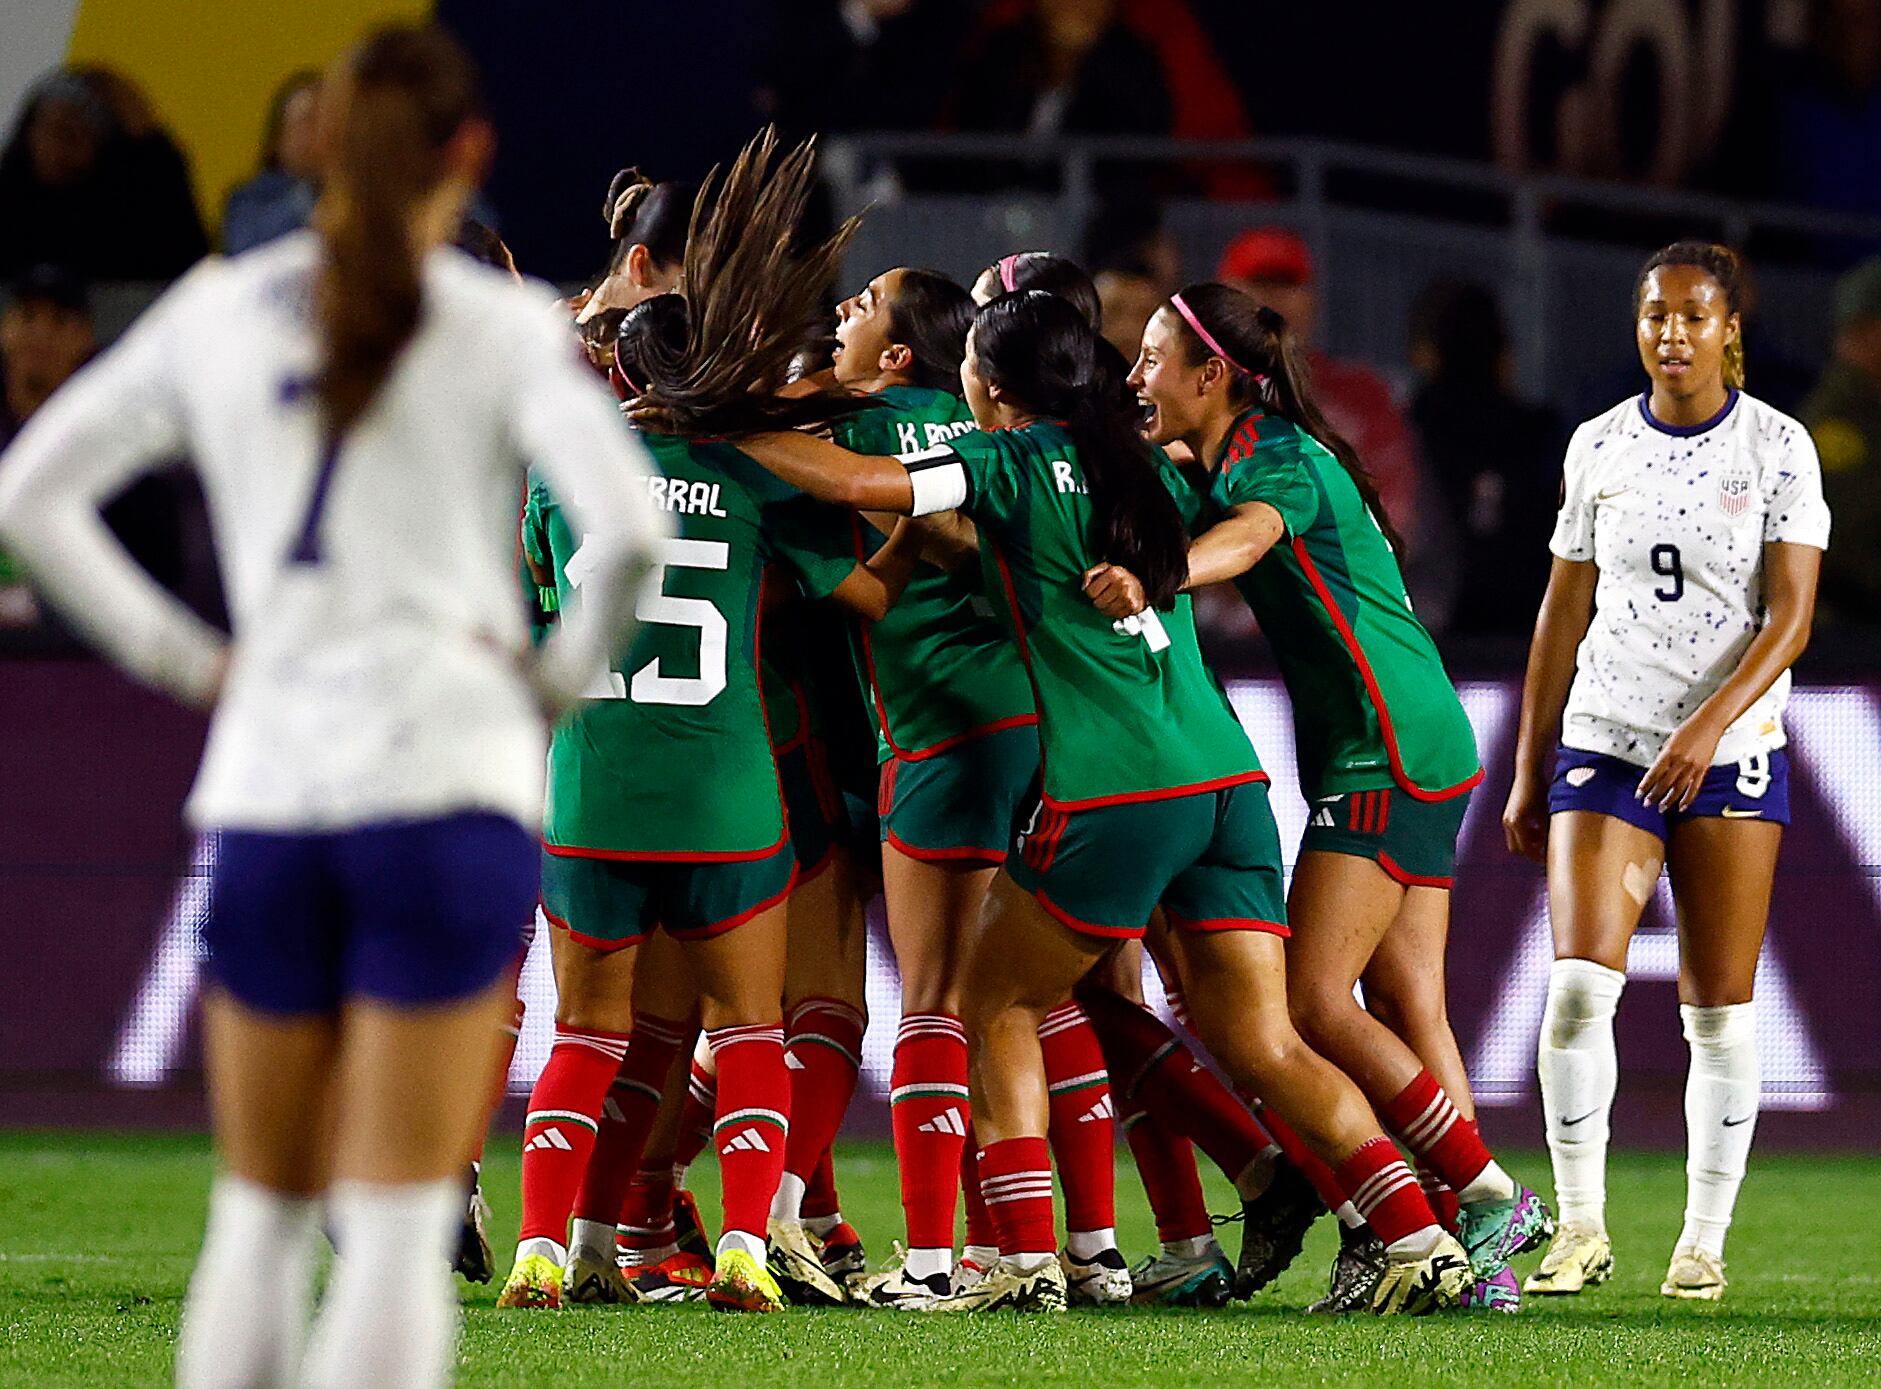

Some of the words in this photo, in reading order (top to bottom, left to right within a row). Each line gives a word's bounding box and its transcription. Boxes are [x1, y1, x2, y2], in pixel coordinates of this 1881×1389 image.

[640, 475, 727, 518] RRAL
[1721, 479, 1749, 496] USA
[1651, 543, 1684, 602] 9
[563, 533, 729, 706] 15
